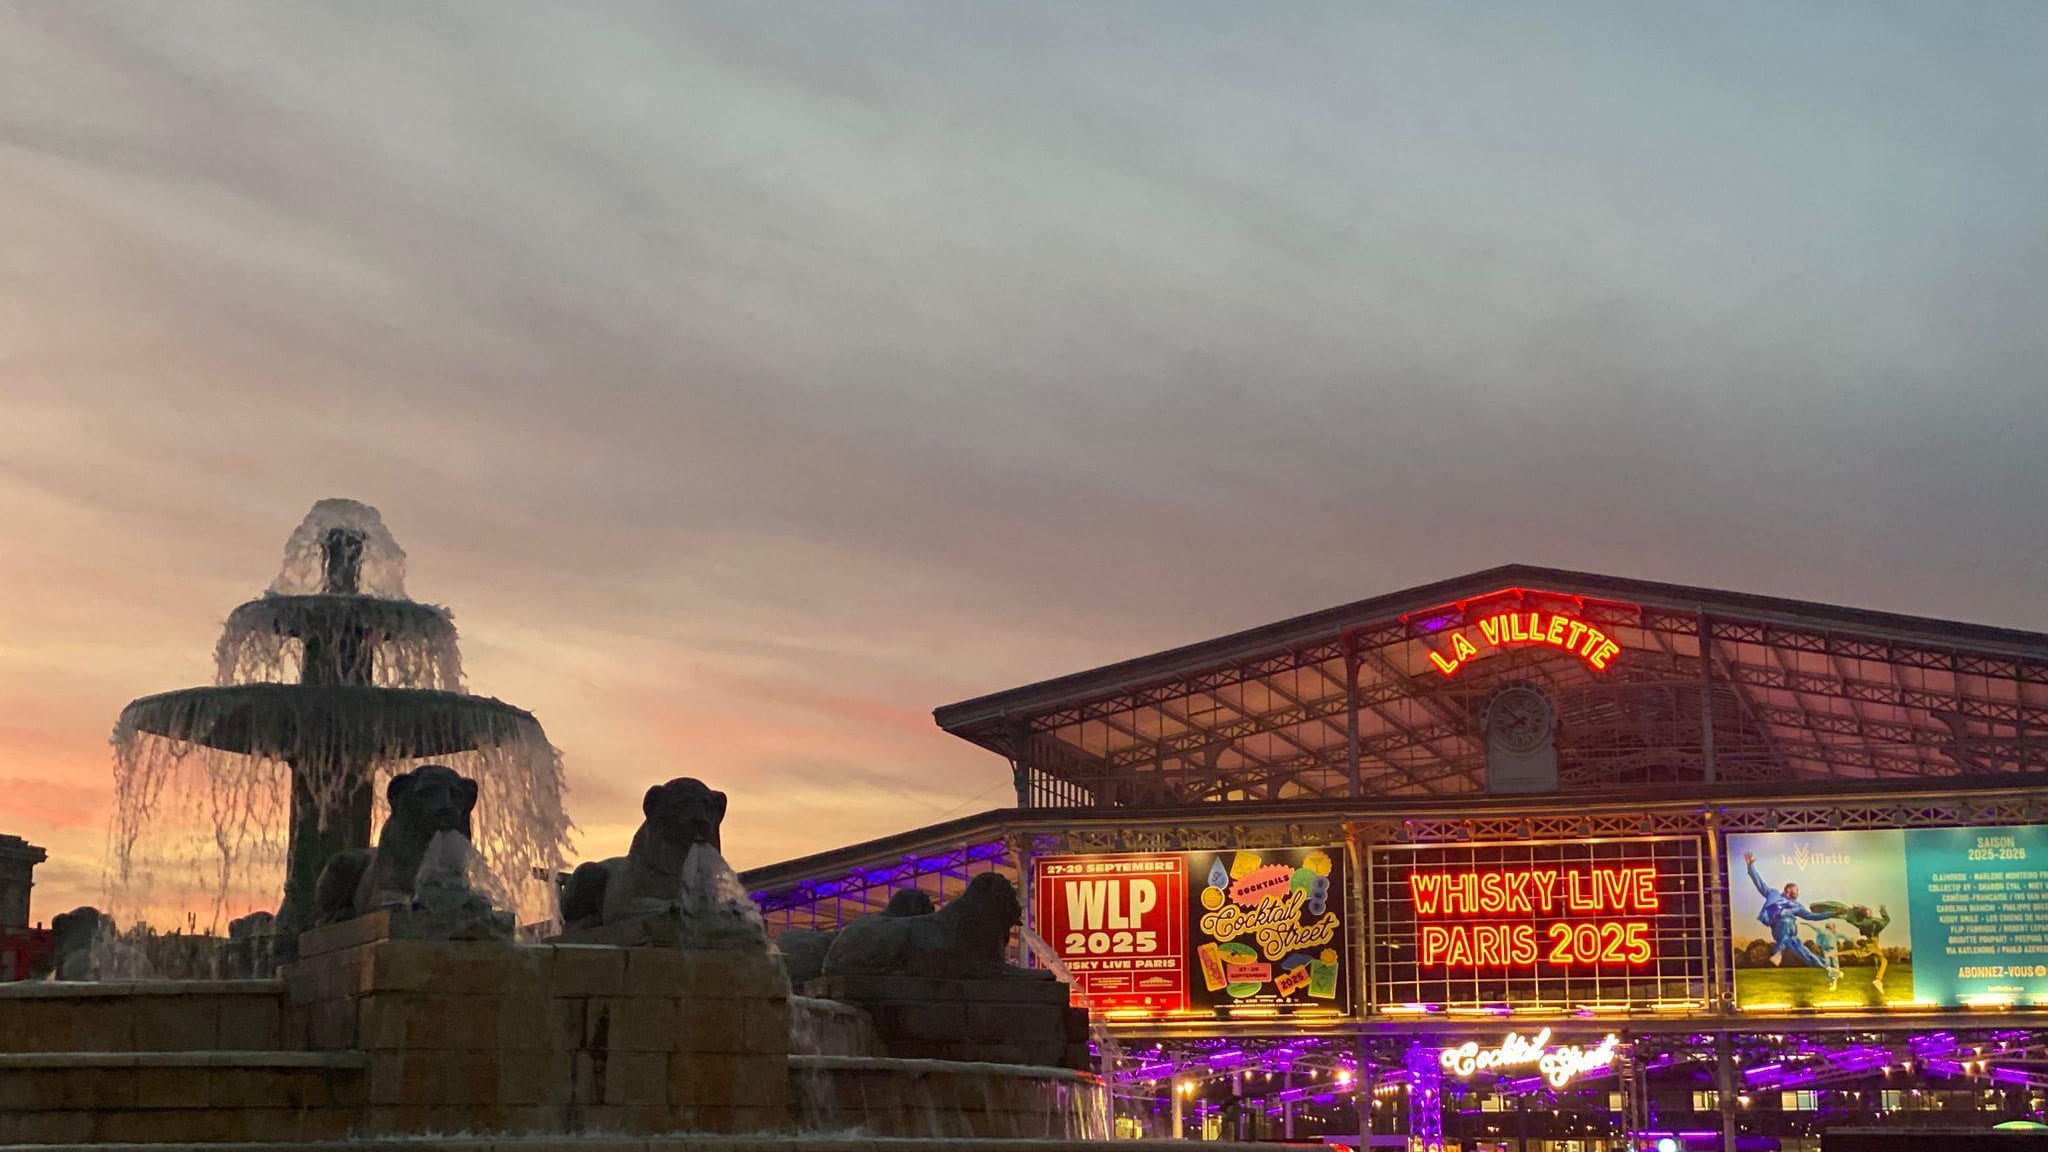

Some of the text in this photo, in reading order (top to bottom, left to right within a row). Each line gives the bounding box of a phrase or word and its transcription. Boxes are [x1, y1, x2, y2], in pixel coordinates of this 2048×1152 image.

[1430, 612, 1620, 674] LA VILLETTE
[1977, 836, 2015, 848] SAISON
[1047, 861, 1175, 874] 27-29 SEPTEMBRE
[1237, 874, 1290, 897] COCKTAILS
[1410, 867, 1659, 914] WHISKY LIVE
[1065, 878, 1157, 931] WLP
[1203, 889, 1303, 938] Cocktail
[1065, 931, 1157, 954] 2025
[1259, 915, 1335, 956] Street
[1423, 922, 1651, 966] PARIS 2025
[1102, 960, 1131, 969] LIVE
[1135, 958, 1176, 969] PARIS
[1958, 966, 2034, 978] ABONNEZ-VOUS
[1280, 971, 1304, 990] 2025
